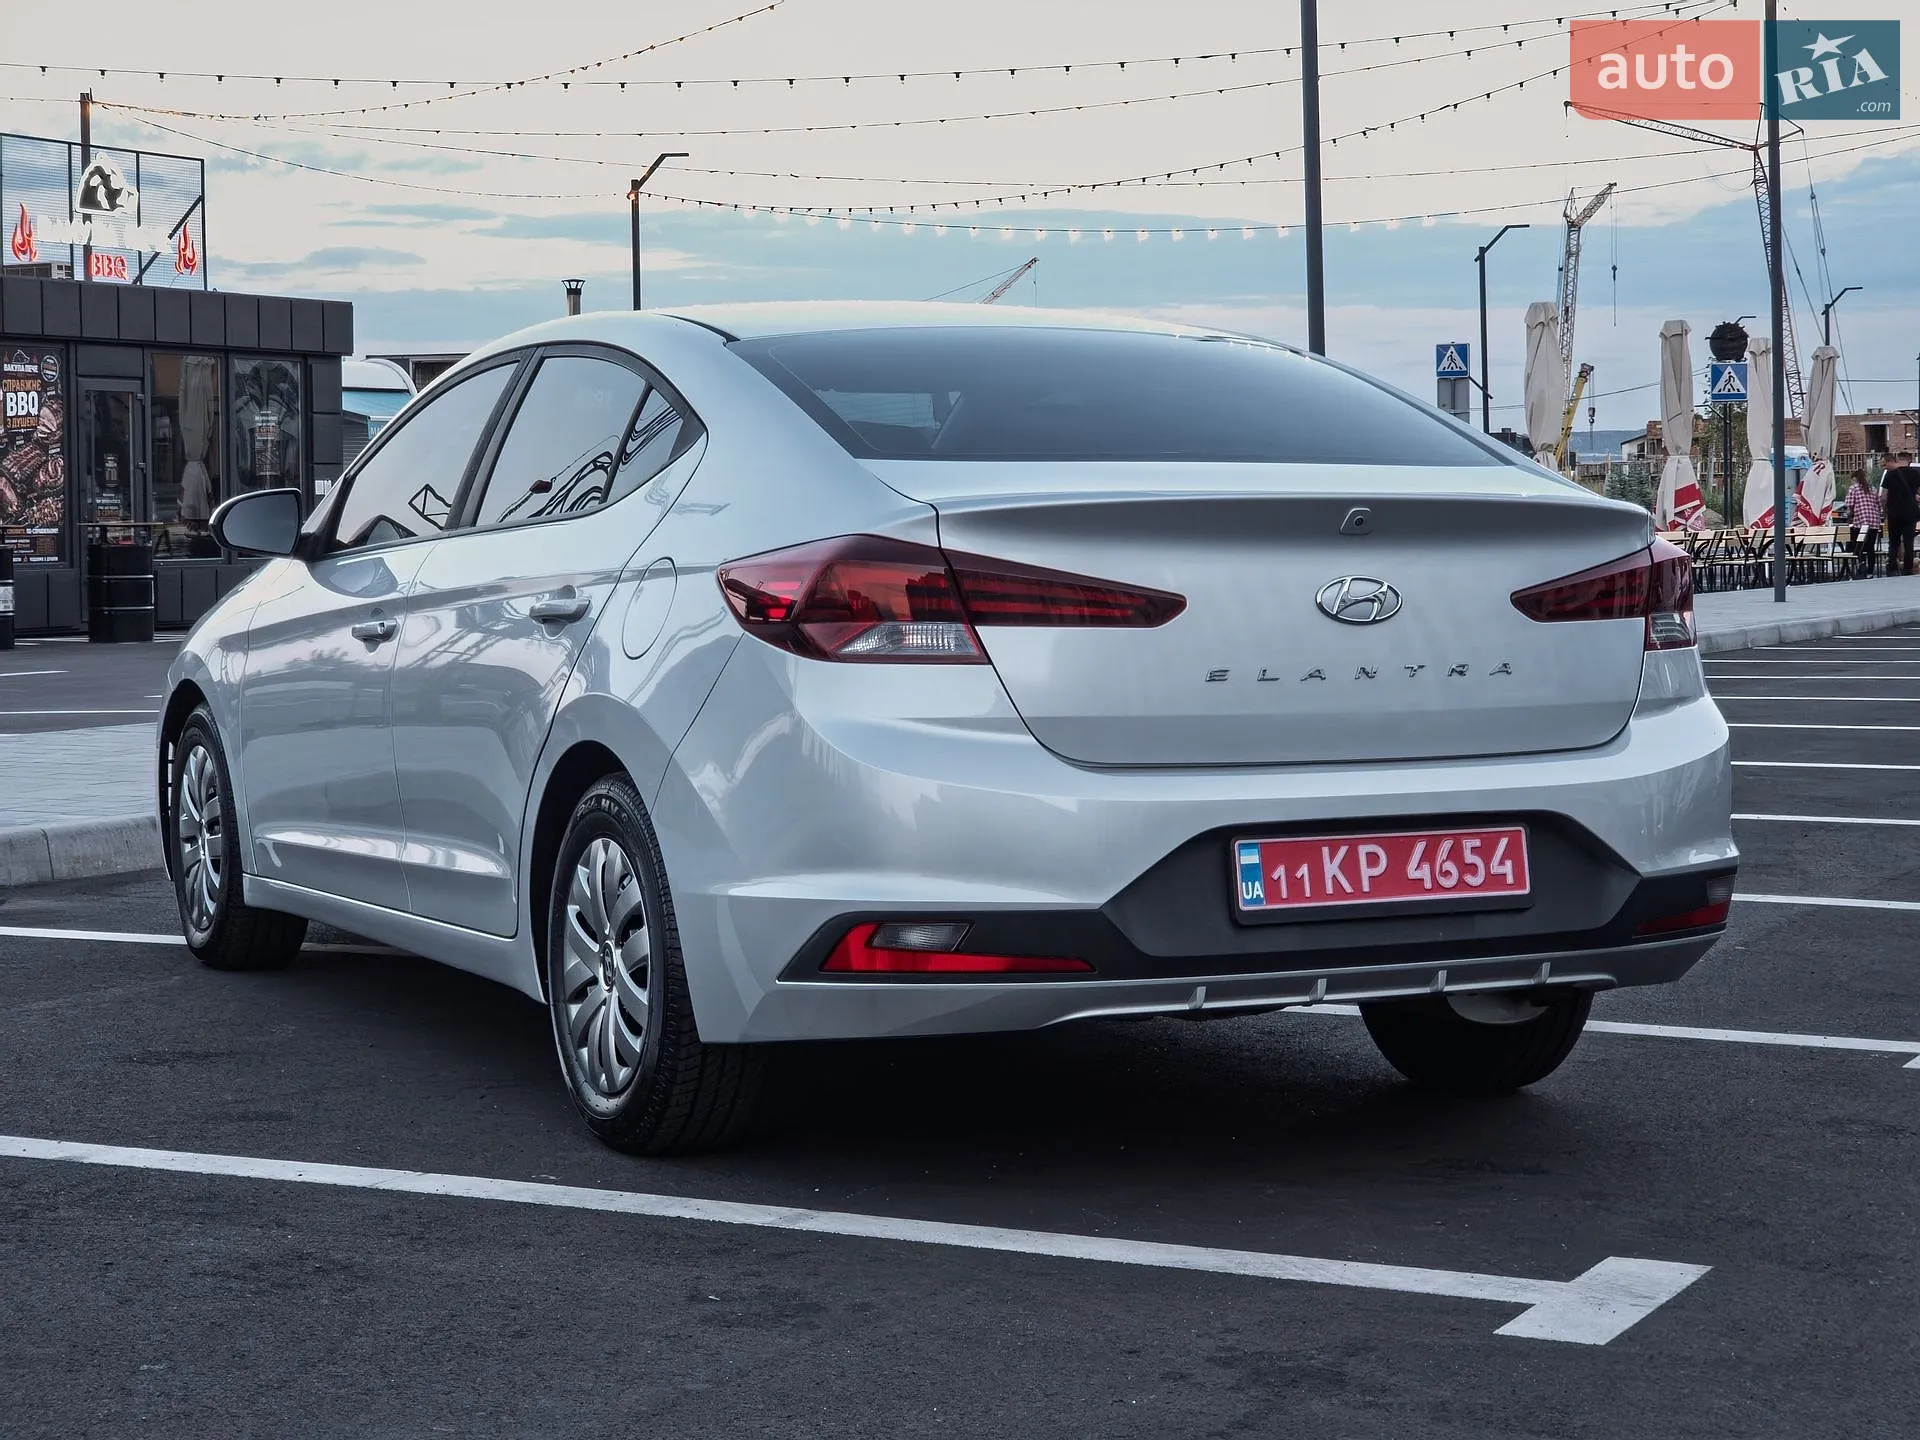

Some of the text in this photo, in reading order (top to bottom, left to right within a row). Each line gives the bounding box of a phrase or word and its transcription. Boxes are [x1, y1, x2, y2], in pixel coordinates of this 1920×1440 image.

[91, 254, 128, 280] BBQ
[6, 391, 38, 416] BBQ
[1204, 662, 1513, 682] ELANTRA
[1407, 838, 1513, 890] 4654
[1242, 881, 1263, 899] UA
